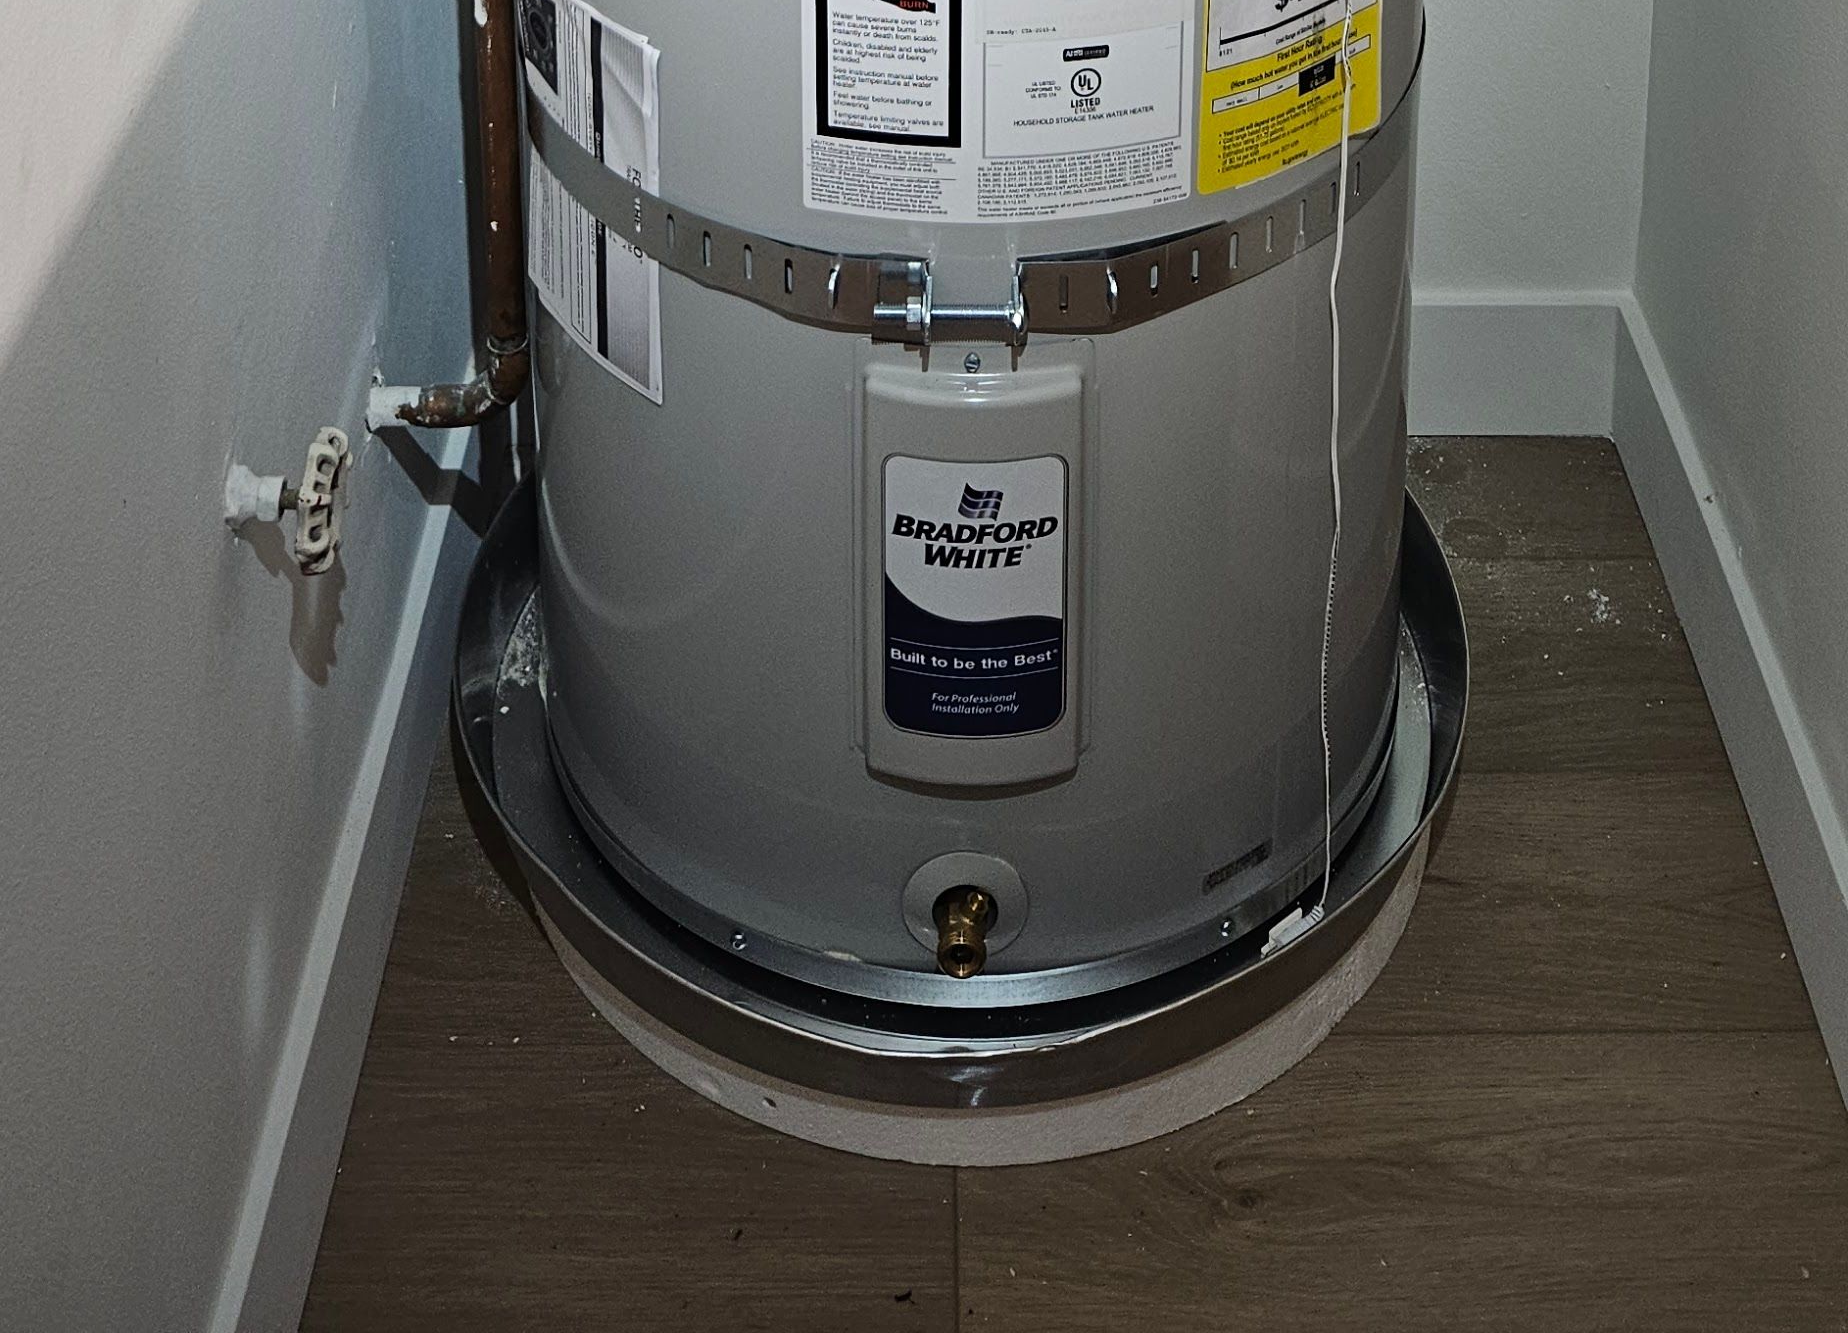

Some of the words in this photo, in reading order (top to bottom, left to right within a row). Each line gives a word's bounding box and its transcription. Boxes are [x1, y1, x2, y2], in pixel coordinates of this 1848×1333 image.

[899, 0, 929, 10] BURN
[832, 11, 853, 20] Water
[856, 14, 899, 24] temperature
[920, 19, 940, 27] 125°F
[847, 22, 869, 30] cause
[832, 28, 861, 38] instantly
[873, 31, 894, 40] death
[895, 33, 912, 41] from
[855, 49, 881, 59] highest
[906, 54, 927, 63] being
[866, 42, 897, 52] disabled
[914, 47, 938, 55] elderly
[1276, 49, 1290, 62] First
[1291, 43, 1305, 56] Hour
[1305, 35, 1323, 51] Rating
[832, 65, 847, 73] See
[849, 67, 886, 78] instruction
[887, 71, 915, 80] manual
[916, 73, 939, 81] before
[1230, 78, 1247, 91] (How
[1247, 73, 1264, 84] much
[1264, 70, 1273, 79] hot
[1273, 65, 1288, 76] water
[1288, 61, 1298, 71] you
[1298, 57, 1307, 67] get
[1312, 49, 1321, 59] the
[1321, 45, 1330, 56] first
[832, 74, 856, 83] setting
[858, 76, 902, 87] temperature
[1078, 74, 1095, 91] UL
[833, 90, 849, 99] Feel
[850, 93, 870, 102] water
[871, 95, 895, 104] before
[896, 97, 924, 107] bathing
[1070, 97, 1101, 109] LISTED
[833, 110, 879, 122] Temperature
[880, 115, 906, 126] limiting
[907, 118, 931, 126] valves
[1013, 117, 1056, 127] HOUSEHOLD
[1056, 114, 1087, 125] STORAGE
[1087, 111, 1105, 122] TANK
[1105, 108, 1129, 119] WATER
[1129, 104, 1155, 116] HEATER
[891, 513, 1059, 545] BRADFORD
[924, 543, 1026, 569] WHITE
[890, 647, 926, 666] Built
[931, 656, 948, 668] to
[953, 657, 975, 669] be
[980, 657, 1008, 669] the
[1014, 649, 1052, 666] Best
[931, 692, 949, 703] For
[950, 691, 1017, 704] Professional
[931, 702, 992, 714] Installation
[994, 702, 1020, 715] Only
